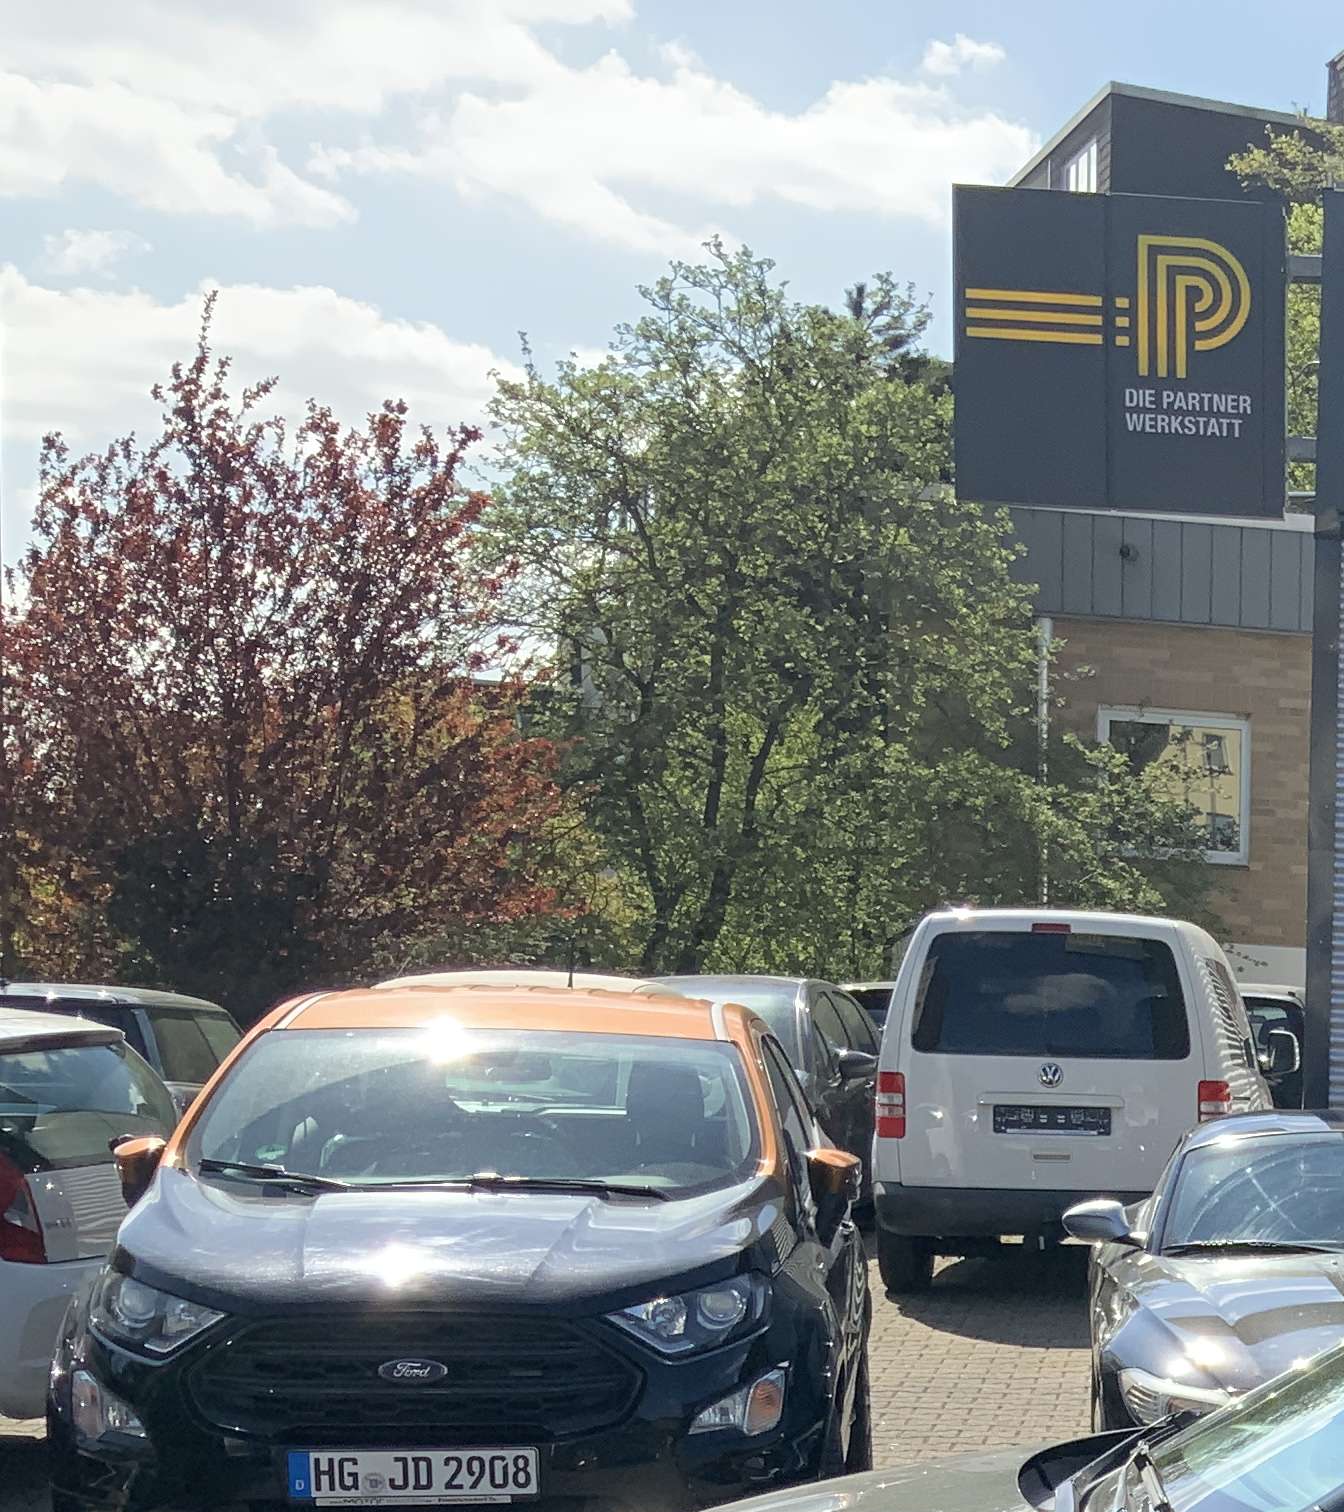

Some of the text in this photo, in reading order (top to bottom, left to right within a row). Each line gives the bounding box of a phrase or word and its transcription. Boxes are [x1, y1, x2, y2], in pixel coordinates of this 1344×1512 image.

[1124, 387, 1252, 415] DIE PARTNER
[1125, 412, 1244, 438] WERKSTATT
[392, 1361, 432, 1379] Ford
[313, 1456, 360, 1492] HG
[388, 1456, 434, 1491] JD
[443, 1454, 532, 1490] 2908
